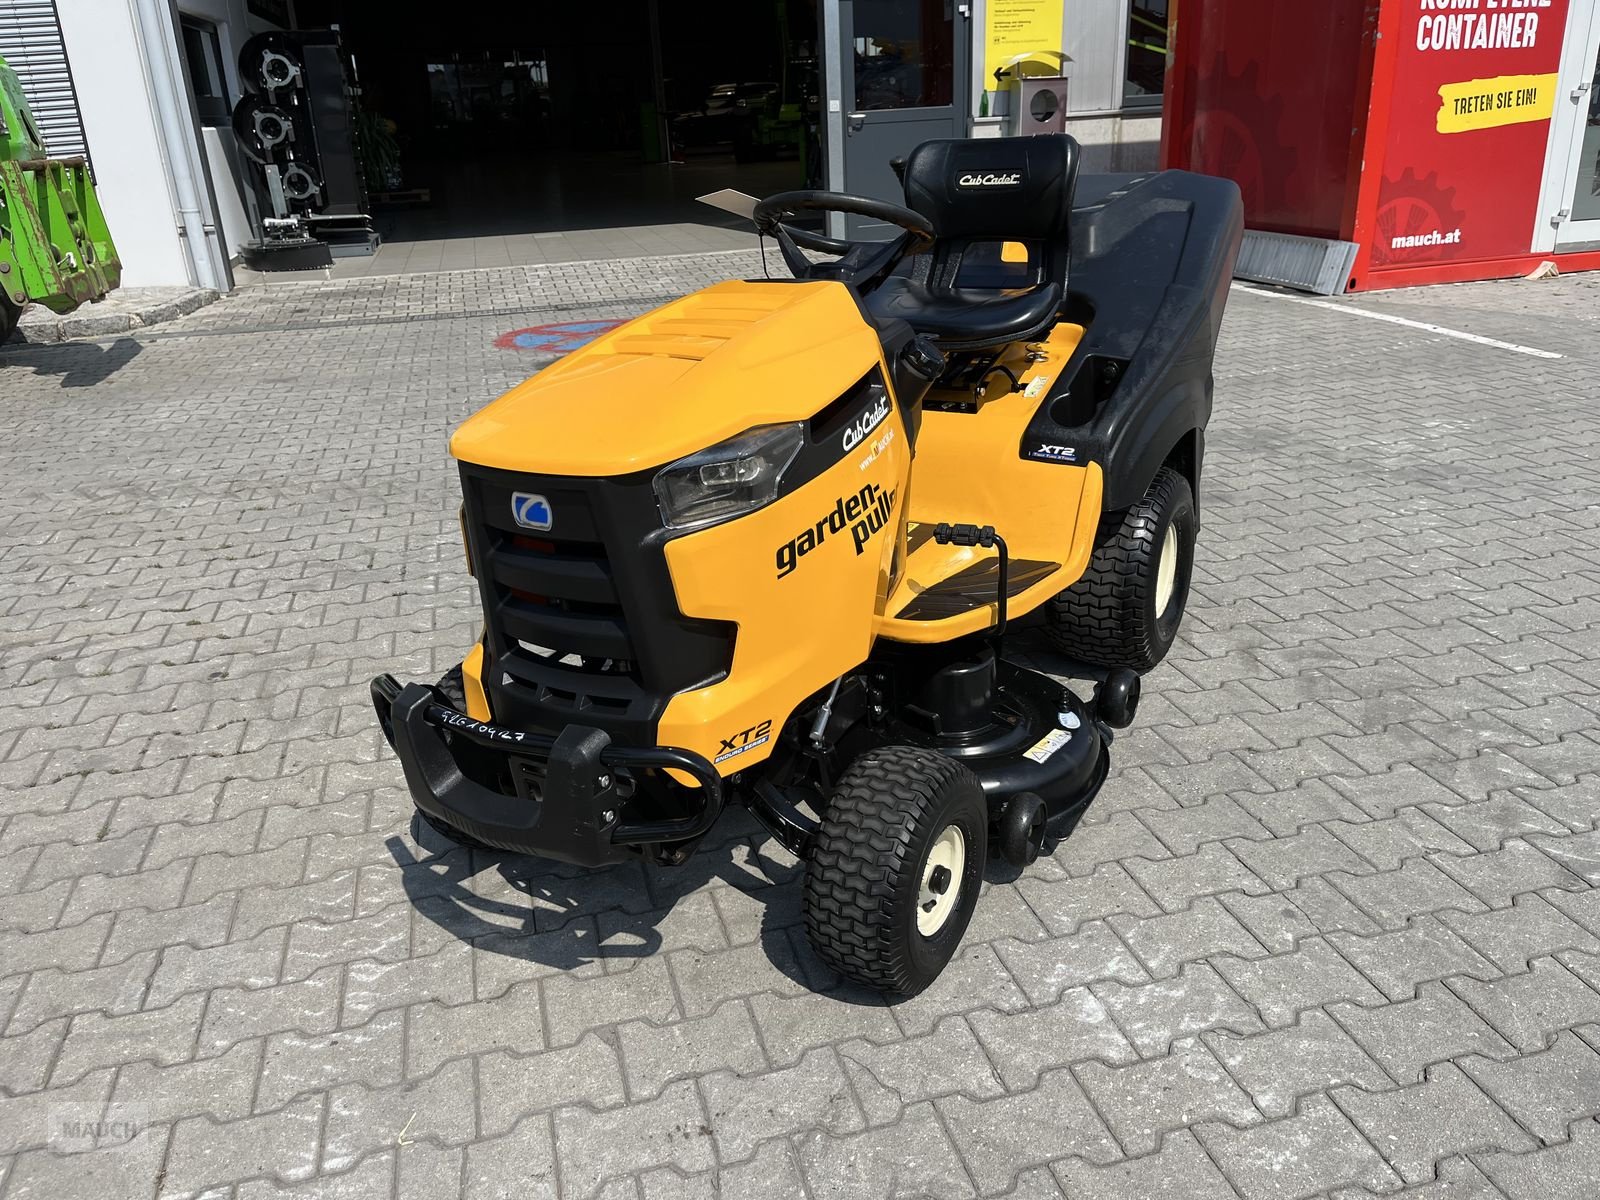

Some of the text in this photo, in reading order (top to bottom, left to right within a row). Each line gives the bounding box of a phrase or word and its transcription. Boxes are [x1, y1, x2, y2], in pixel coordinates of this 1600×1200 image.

[1416, 12, 1539, 51] CONTAINER
[1454, 88, 1537, 115] TRETEN SIE EIN!
[959, 173, 1020, 186] Cub Cadet
[1391, 229, 1461, 249] mauch.at
[842, 396, 889, 452] Cub Cadet
[1038, 444, 1076, 457] XT2
[776, 483, 880, 580] garden-
[715, 719, 772, 756] XT2
